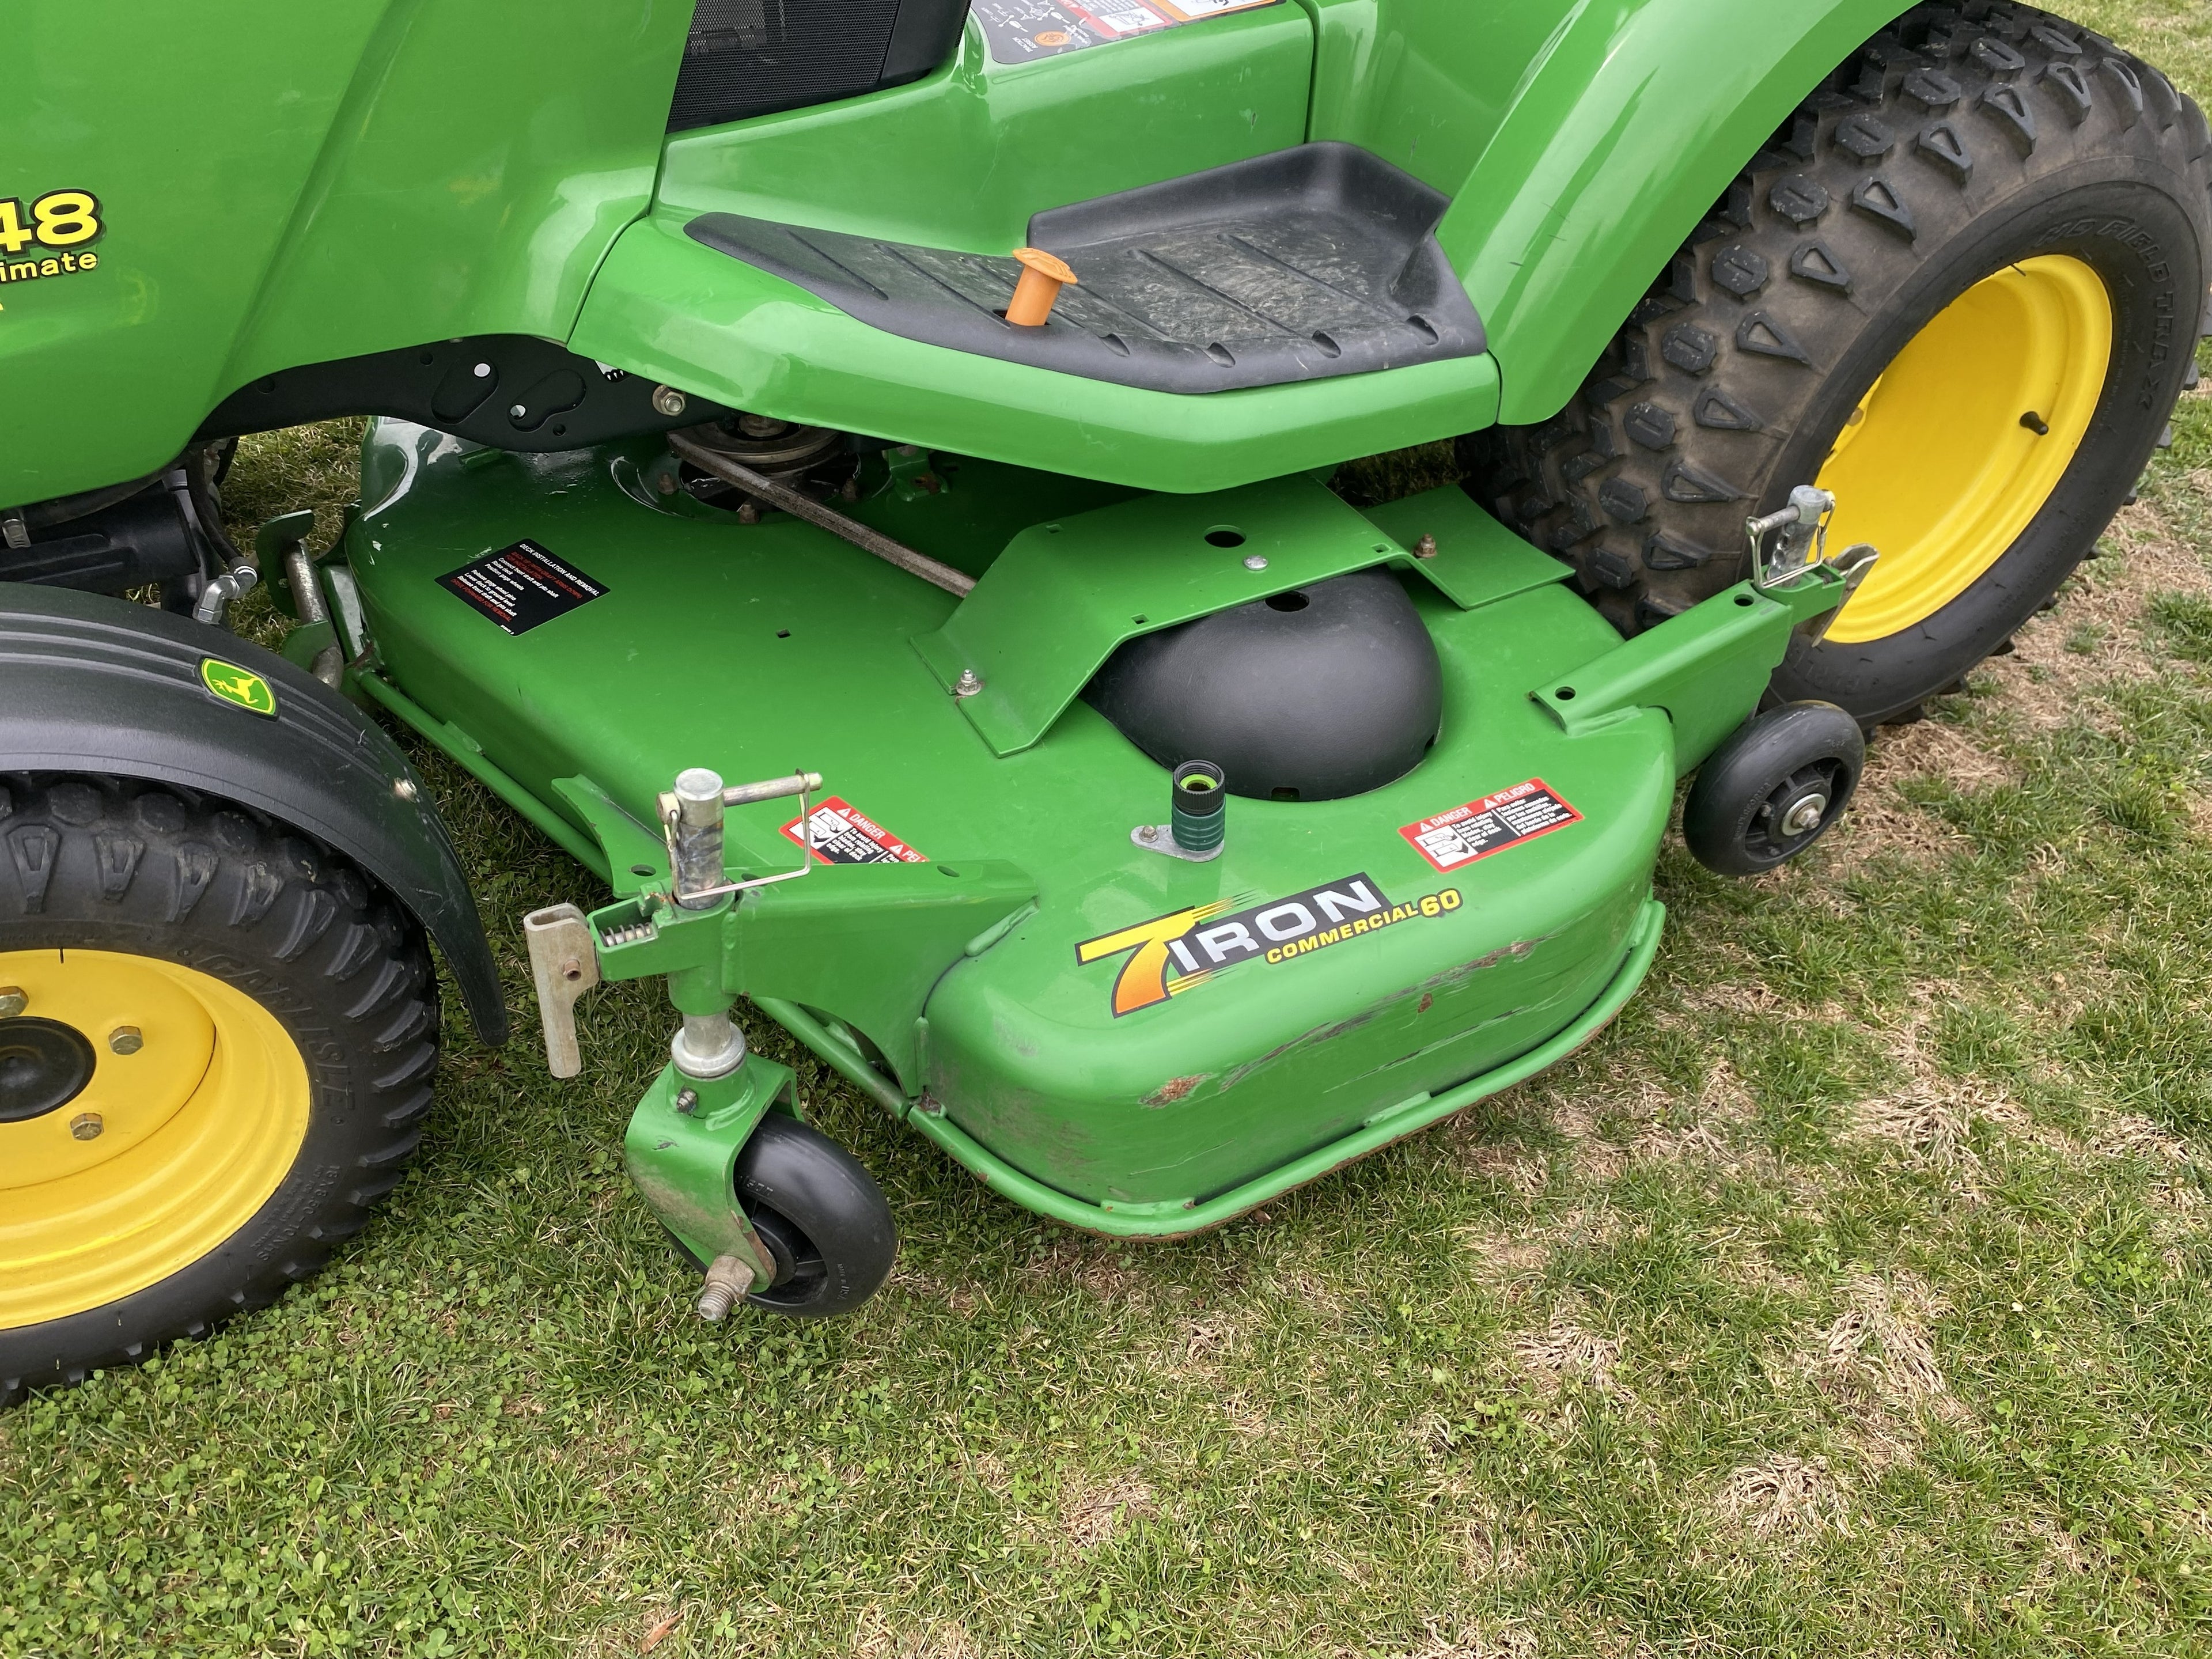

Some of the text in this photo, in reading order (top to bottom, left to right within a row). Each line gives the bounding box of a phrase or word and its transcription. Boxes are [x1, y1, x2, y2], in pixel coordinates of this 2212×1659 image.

[2096, 219, 2171, 283] FIELD
[2137, 290, 2175, 411] TRAX
[519, 543, 600, 596] DECK INSTALLATION AND REMOVAL
[1493, 783, 1535, 803] PELIGRO
[849, 813, 886, 839] DANGER
[1430, 806, 1472, 827] DANGER
[1460, 817, 1477, 827] avoid
[1474, 812, 1493, 822] injury
[843, 831, 857, 842] from
[1456, 825, 1472, 834] from
[1466, 834, 1482, 843] clear
[1487, 826, 1502, 835] deck
[832, 839, 862, 861] clear of deck
[855, 832, 872, 844] avoid
[865, 840, 884, 853] injury
